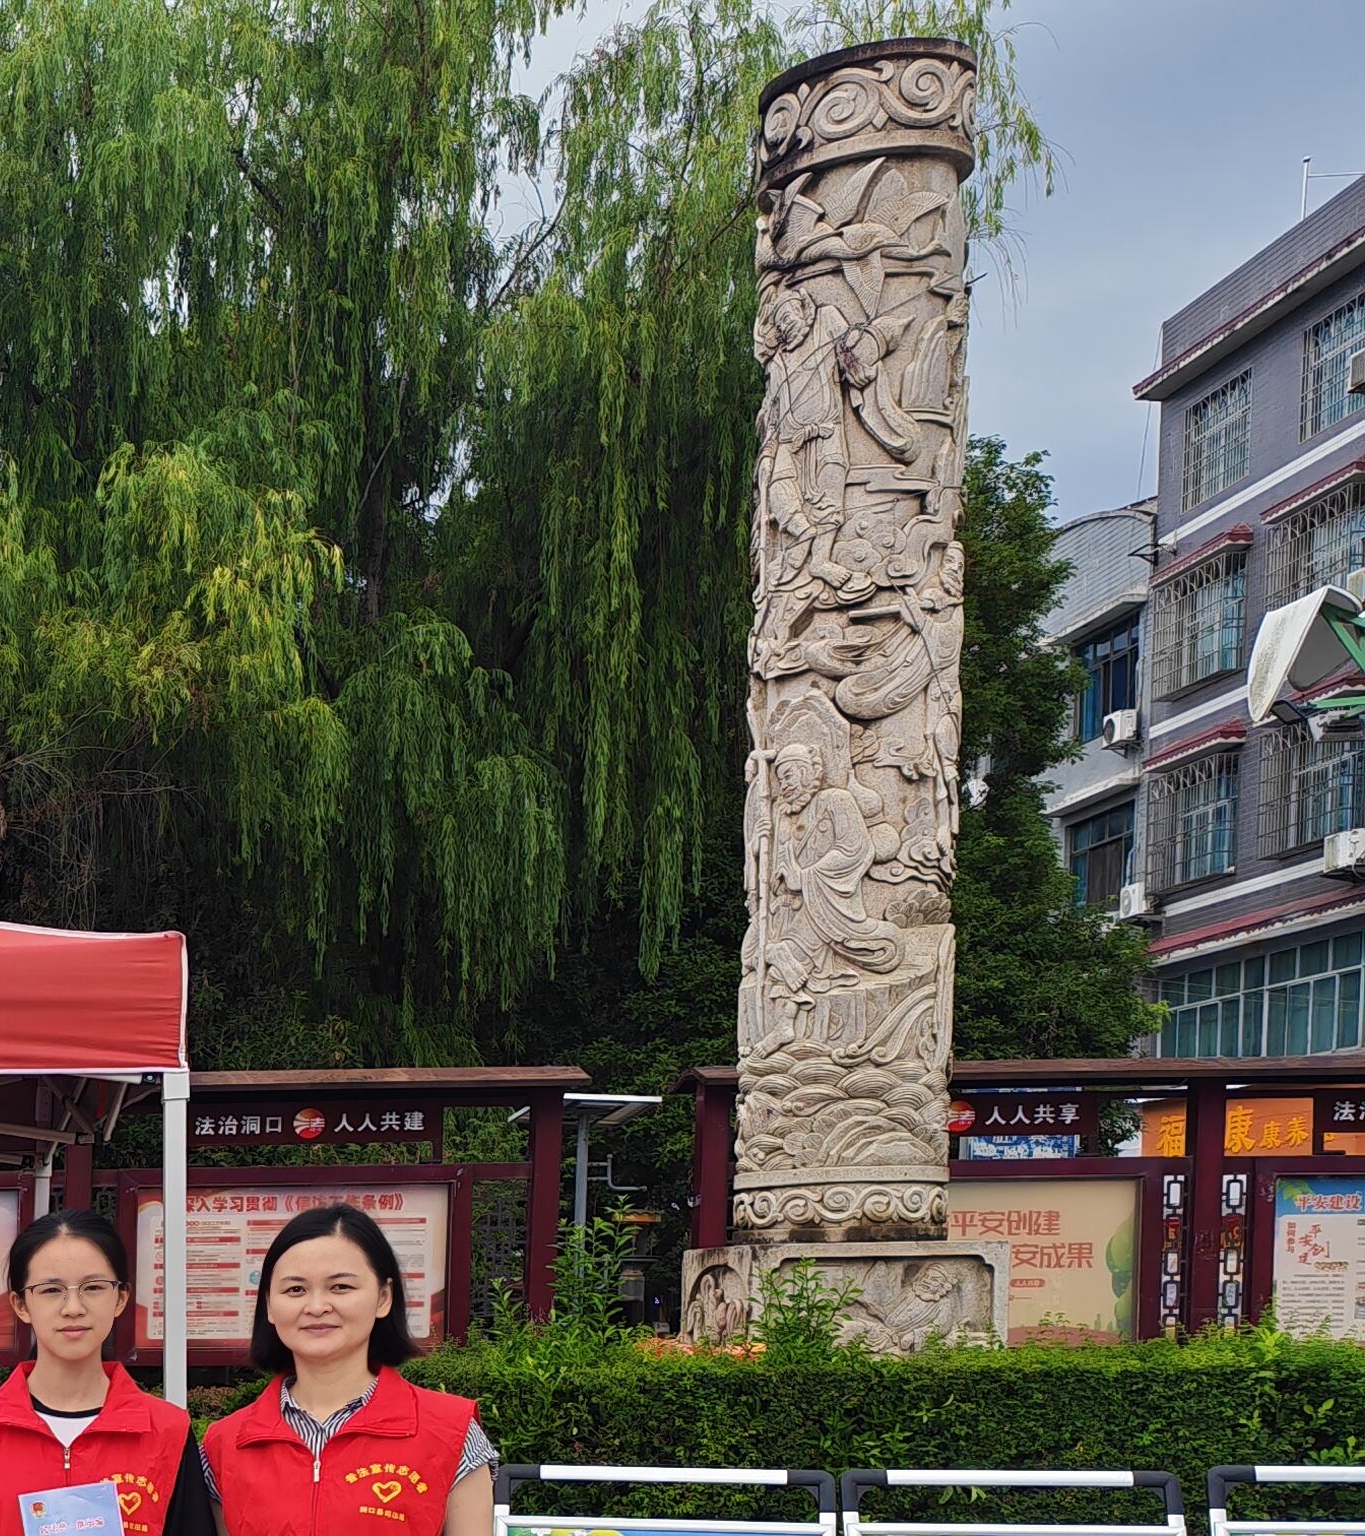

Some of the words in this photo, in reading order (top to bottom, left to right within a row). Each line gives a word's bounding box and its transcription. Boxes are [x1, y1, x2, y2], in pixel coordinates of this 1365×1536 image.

[195, 1115, 282, 1136] 法治洞口
[334, 1111, 425, 1133] 人人共建
[985, 1103, 1080, 1125] 人人共享
[1295, 1194, 1361, 1211] 平安建设
[950, 1210, 1061, 1236] 平安创建
[1013, 1242, 1093, 1268] 安成果
